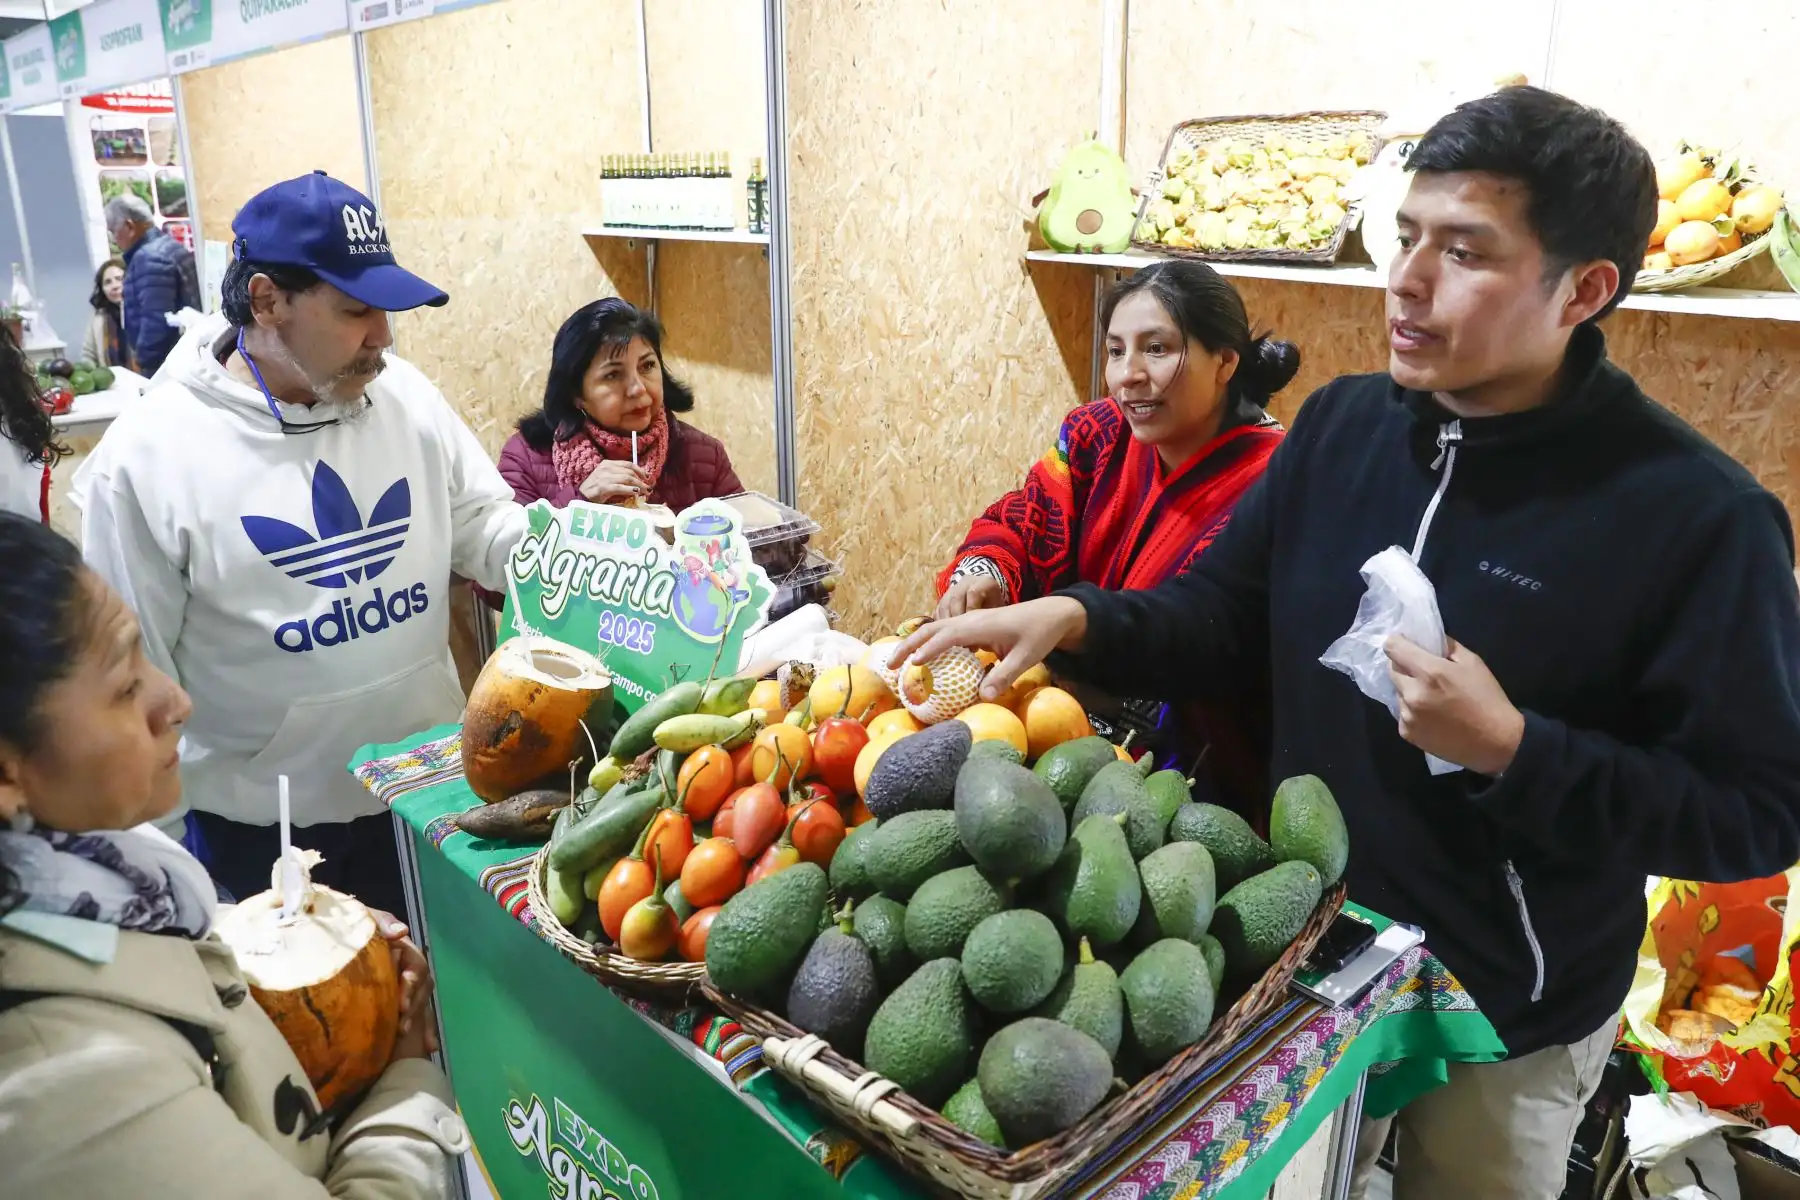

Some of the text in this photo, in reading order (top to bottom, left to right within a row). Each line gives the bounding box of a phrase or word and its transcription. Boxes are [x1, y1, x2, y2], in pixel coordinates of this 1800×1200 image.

[348, 244, 379, 254] BACK
[569, 507, 648, 549] EXPO
[513, 517, 679, 616] Agraria
[1491, 566, 1542, 590] HI-TEC
[273, 582, 429, 653] adidas
[598, 611, 656, 655] 2025
[643, 690, 657, 703] co
[501, 1092, 626, 1200] Agr
[553, 1096, 660, 1200] EXPO
